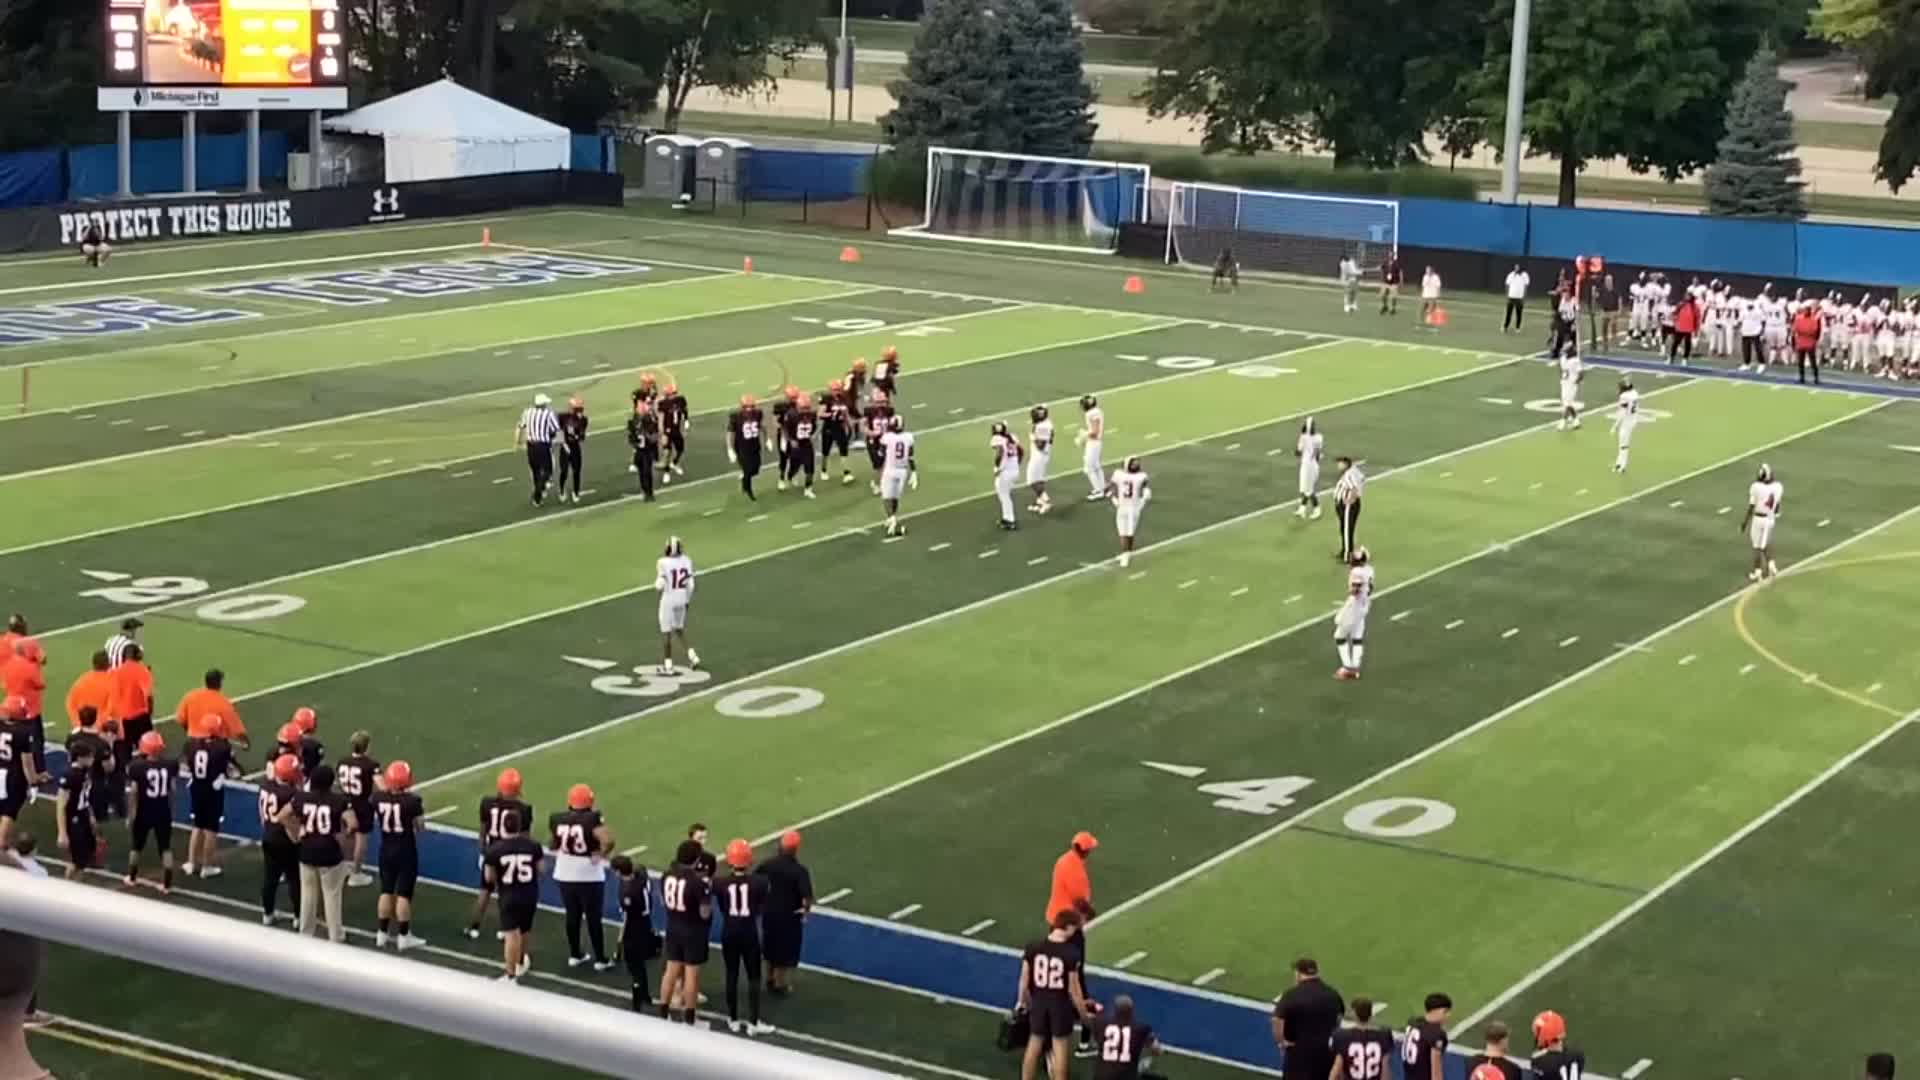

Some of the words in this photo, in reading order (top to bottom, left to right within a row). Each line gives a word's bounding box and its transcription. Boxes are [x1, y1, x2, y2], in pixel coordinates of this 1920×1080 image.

[59, 207, 162, 244] PROTECT
[168, 204, 221, 235] THIS
[225, 200, 291, 232] HOUSE
[186, 254, 652, 305] TECH
[742, 421, 759, 440] 65
[895, 441, 906, 460] 9
[1123, 480, 1134, 498] 3
[670, 567, 690, 590] 12
[194, 749, 209, 778] 8
[146, 767, 168, 798] 31
[338, 764, 363, 796] 25
[303, 802, 332, 835] 70
[378, 801, 404, 833] 71
[1196, 775, 1456, 837] 40
[556, 823, 588, 854] 73
[500, 853, 533, 885] 75
[664, 875, 687, 912] 81
[728, 883, 751, 917] 11
[1033, 953, 1065, 989] 82
[1102, 1024, 1132, 1062] 21
[1348, 1042, 1382, 1080] 32
